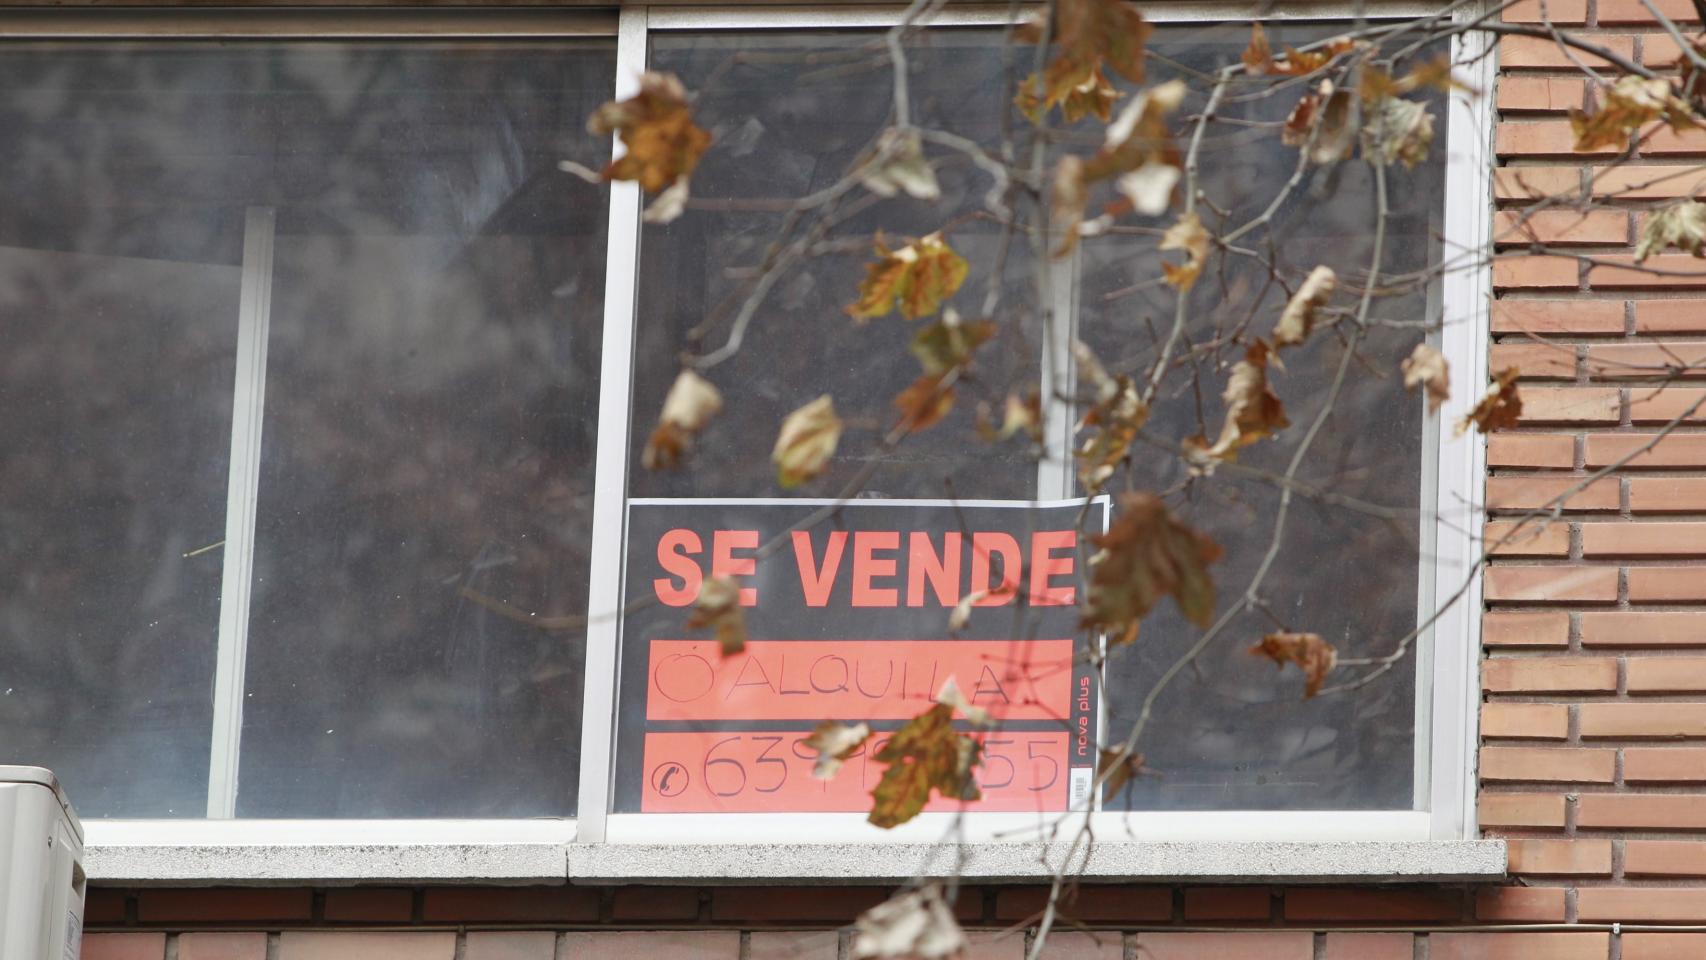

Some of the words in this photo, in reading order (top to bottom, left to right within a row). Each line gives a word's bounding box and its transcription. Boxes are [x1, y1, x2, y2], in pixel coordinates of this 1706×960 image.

[653, 529, 760, 607] SE
[791, 530, 1077, 608] VENDE
[726, 654, 1011, 705] ALQUILA
[1077, 676, 1091, 711] plus
[1077, 715, 1089, 757] nova
